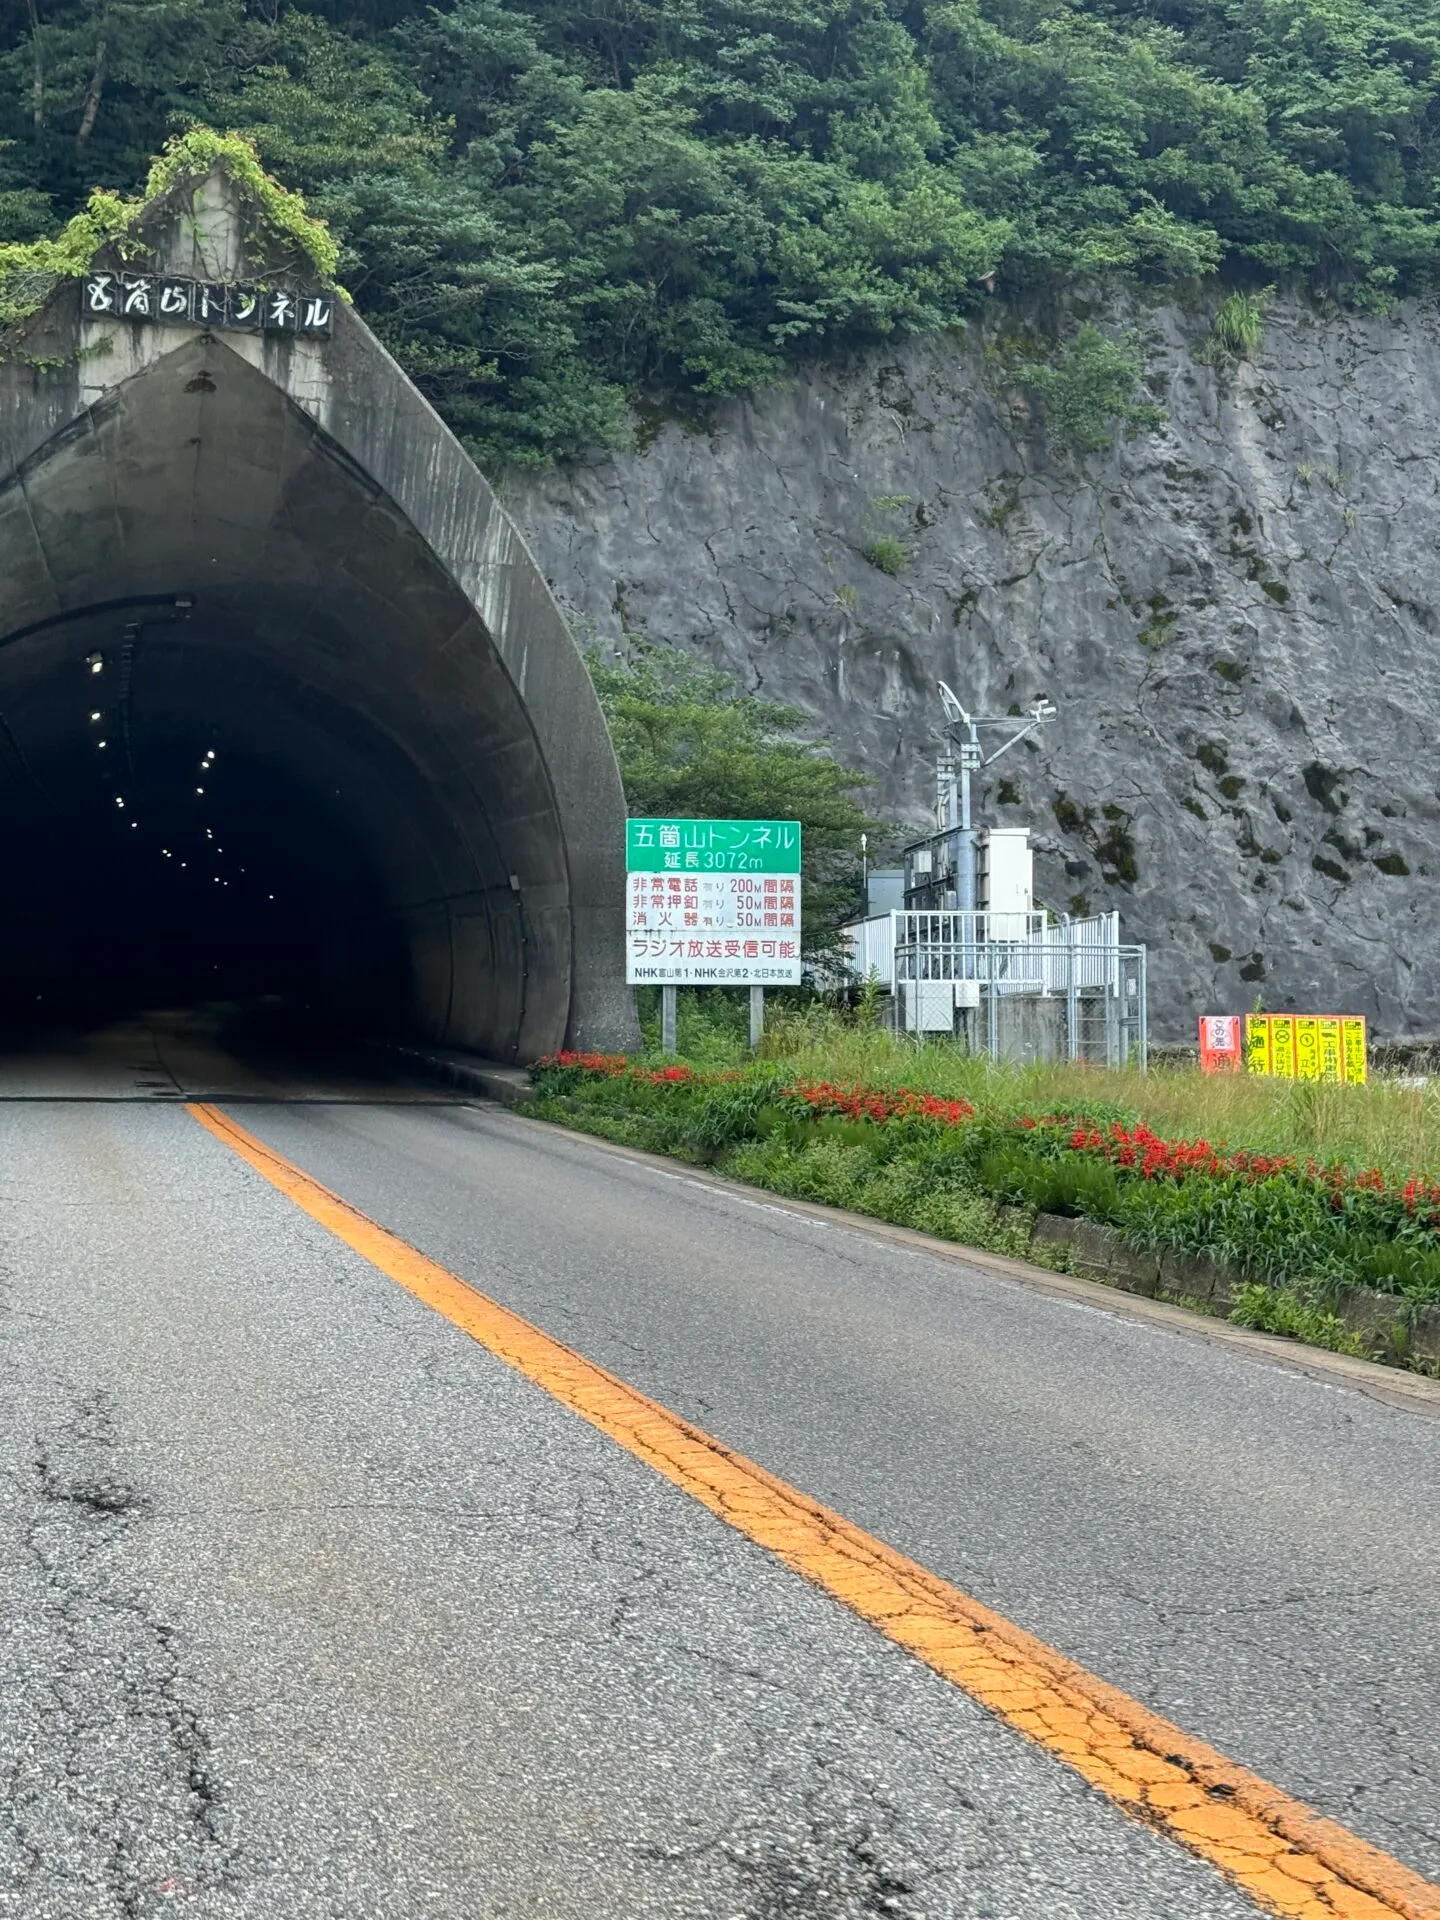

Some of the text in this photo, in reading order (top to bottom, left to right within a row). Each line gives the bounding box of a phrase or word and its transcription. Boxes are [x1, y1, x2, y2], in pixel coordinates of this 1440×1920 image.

[632, 824, 795, 849] 五箇山トンネル
[632, 939, 796, 959] ラジオ放送受信可能
[1214, 1019, 1226, 1047] この先
